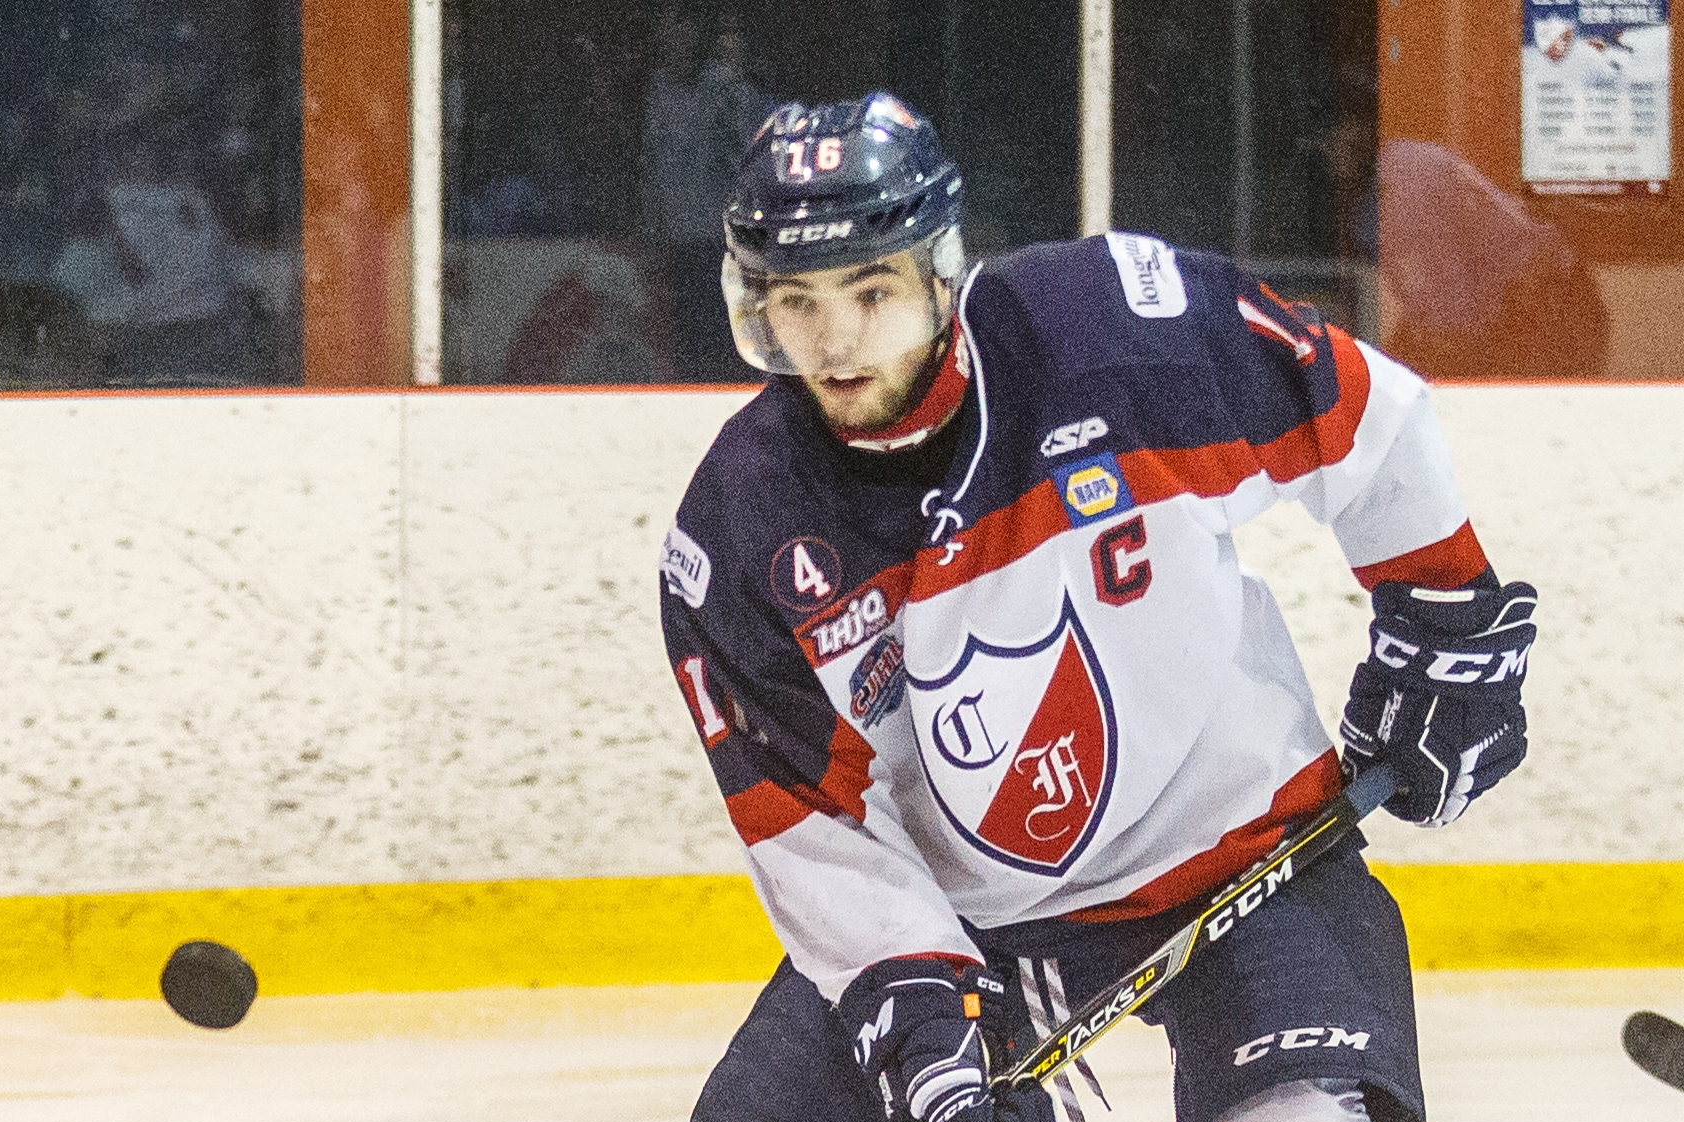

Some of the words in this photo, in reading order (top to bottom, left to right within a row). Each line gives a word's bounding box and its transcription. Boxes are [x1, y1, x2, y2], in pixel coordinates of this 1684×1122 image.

[777, 220, 853, 245] CCM
[1073, 478, 1113, 505] NAPA
[793, 542, 831, 597] 4
[1090, 514, 1152, 608] C
[1374, 629, 1532, 684] CCM
[931, 689, 1009, 771] C
[1205, 857, 1295, 942] CCM
[1032, 1049, 1061, 1079] PER
[1058, 984, 1136, 1060] TACKS
[1233, 1027, 1371, 1067] CCM
